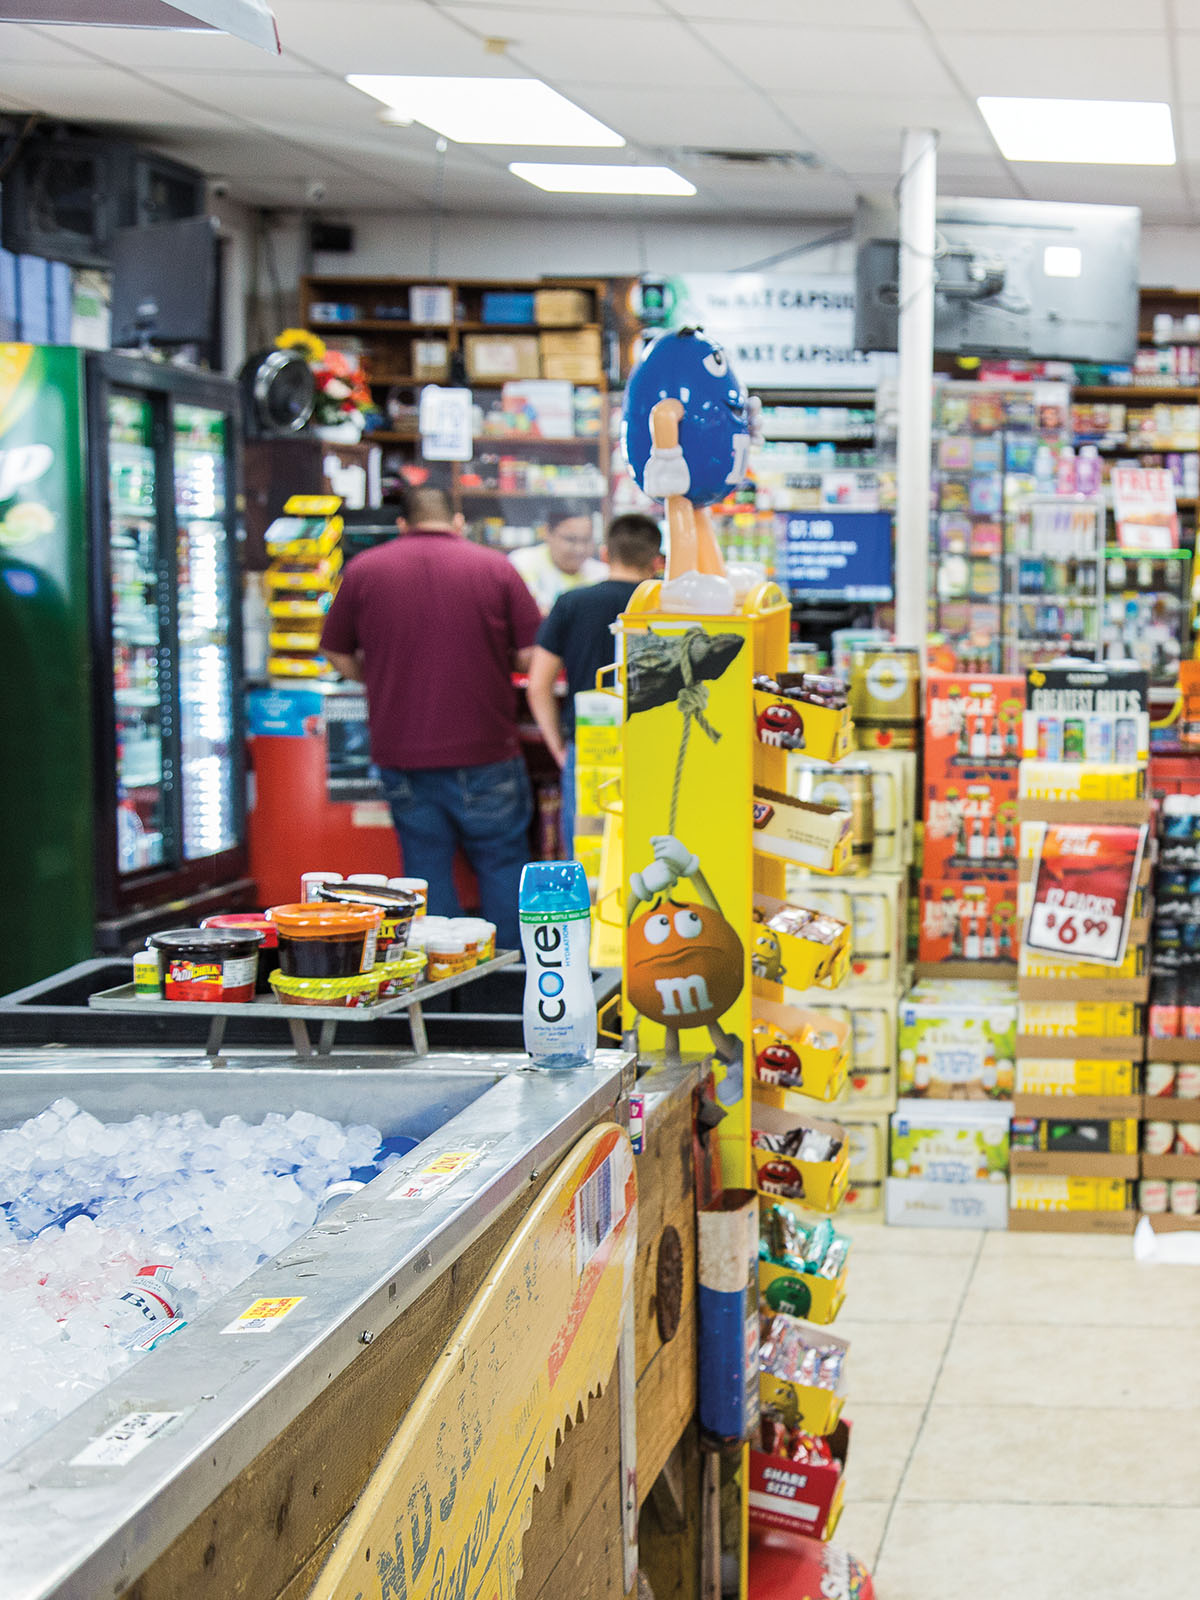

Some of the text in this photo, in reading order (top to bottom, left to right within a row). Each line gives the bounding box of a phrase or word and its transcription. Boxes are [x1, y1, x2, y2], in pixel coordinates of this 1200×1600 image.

[1117, 470, 1168, 492] FREE
[1096, 690, 1142, 712] HITS
[1060, 839, 1100, 855] SALE
[1064, 891, 1116, 916] PACKS
[534, 924, 566, 1023] core
[654, 974, 714, 1016] m
[763, 1467, 808, 1489] SHARE
[765, 1481, 797, 1498] SIZE
